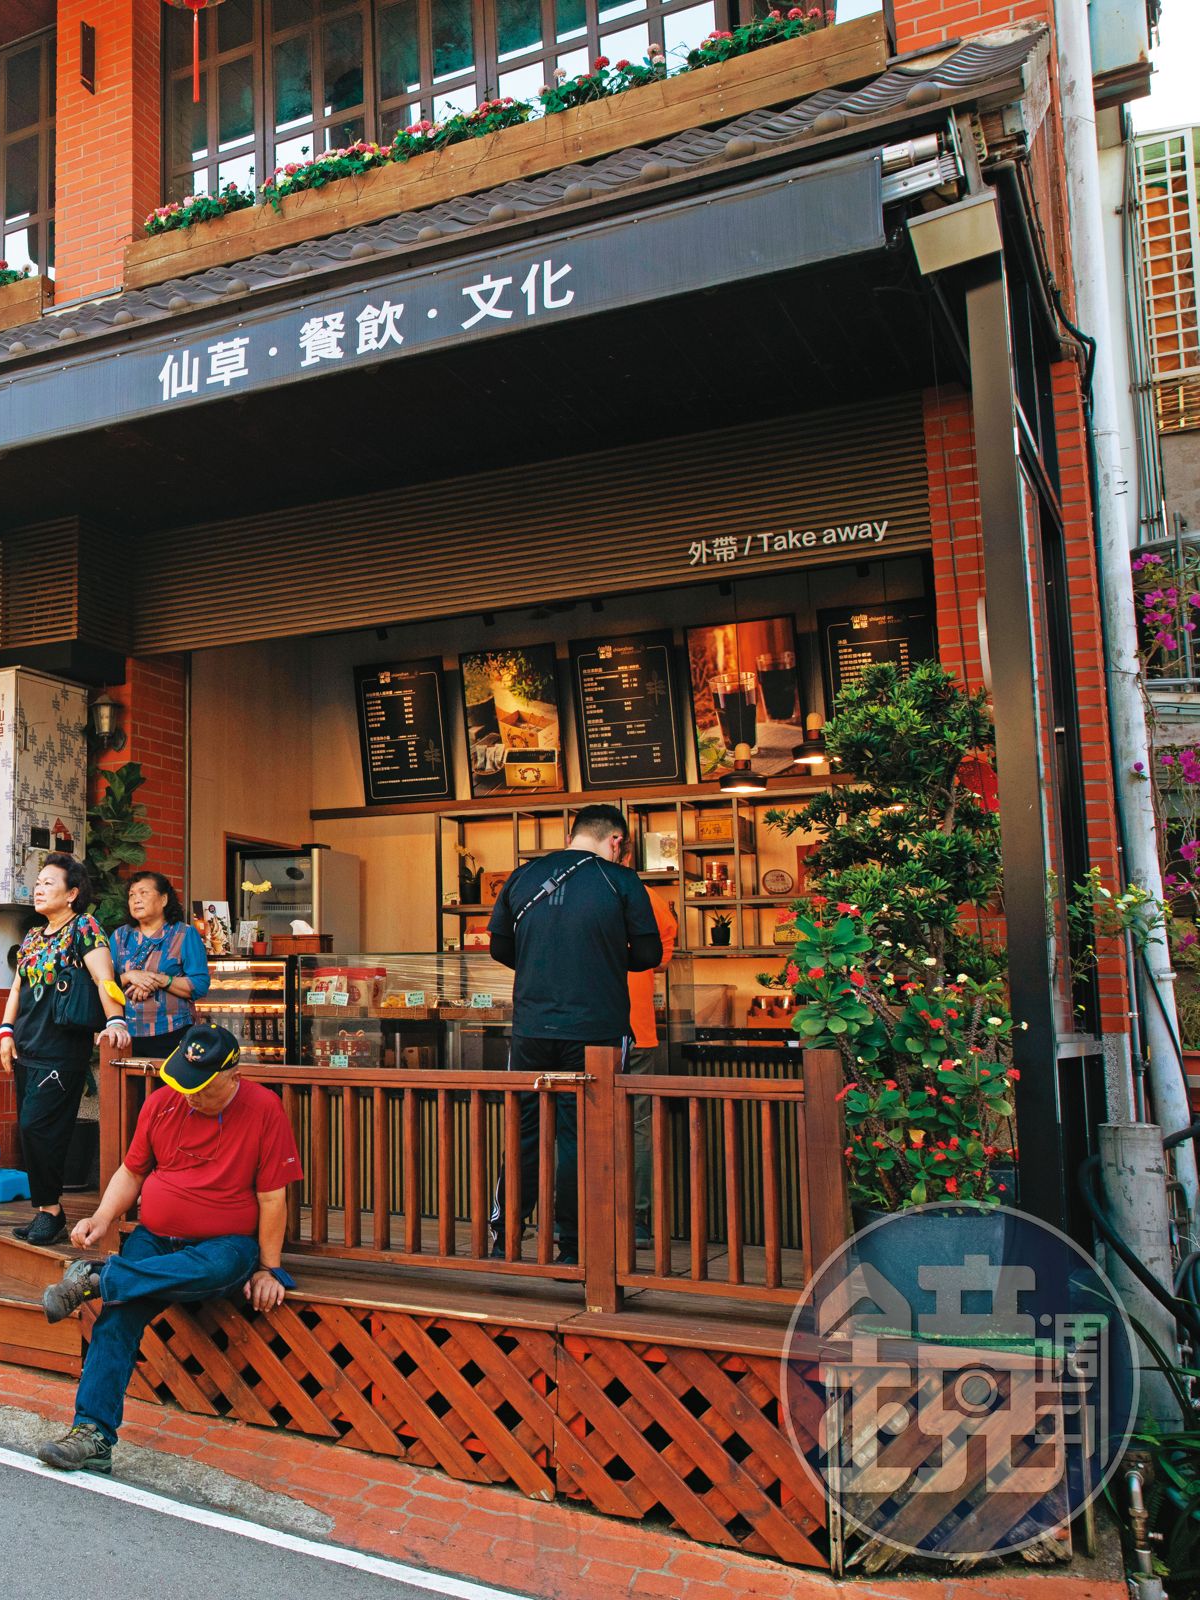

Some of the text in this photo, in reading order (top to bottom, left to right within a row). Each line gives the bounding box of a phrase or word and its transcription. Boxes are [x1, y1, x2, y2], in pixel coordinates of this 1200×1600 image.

[688, 535, 738, 566] 外帶
[757, 529, 817, 553] Take
[822, 520, 889, 543] away
